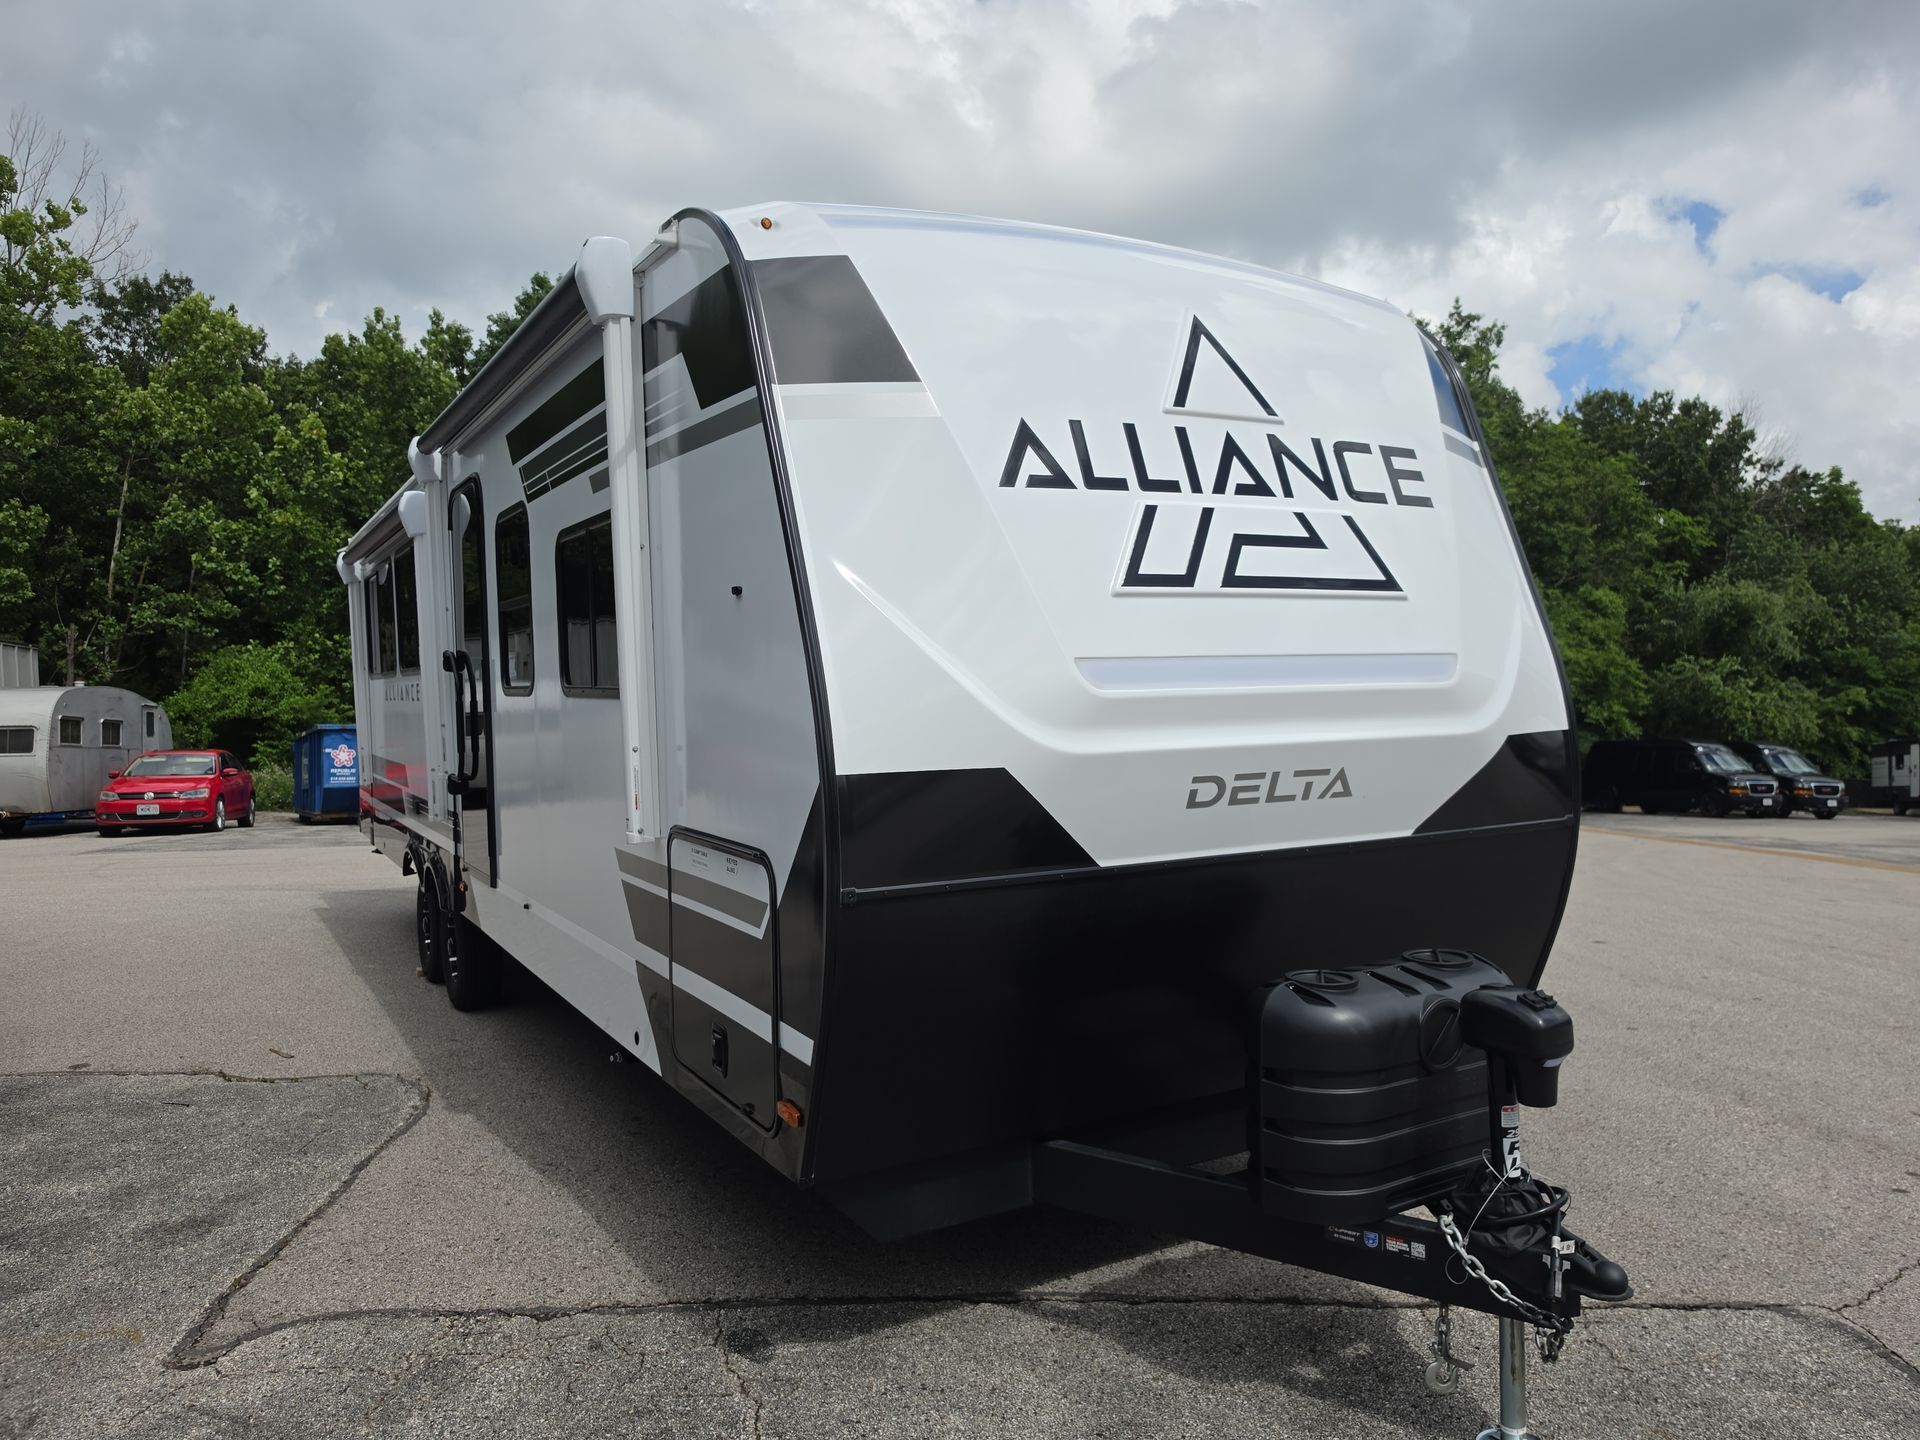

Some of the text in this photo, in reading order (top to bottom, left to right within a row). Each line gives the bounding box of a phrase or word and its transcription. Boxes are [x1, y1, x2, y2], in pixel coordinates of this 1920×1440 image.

[998, 417, 1434, 509] ALLIANCE
[385, 683, 420, 702] ALLIANCE
[1185, 766, 1353, 810] DELTA
